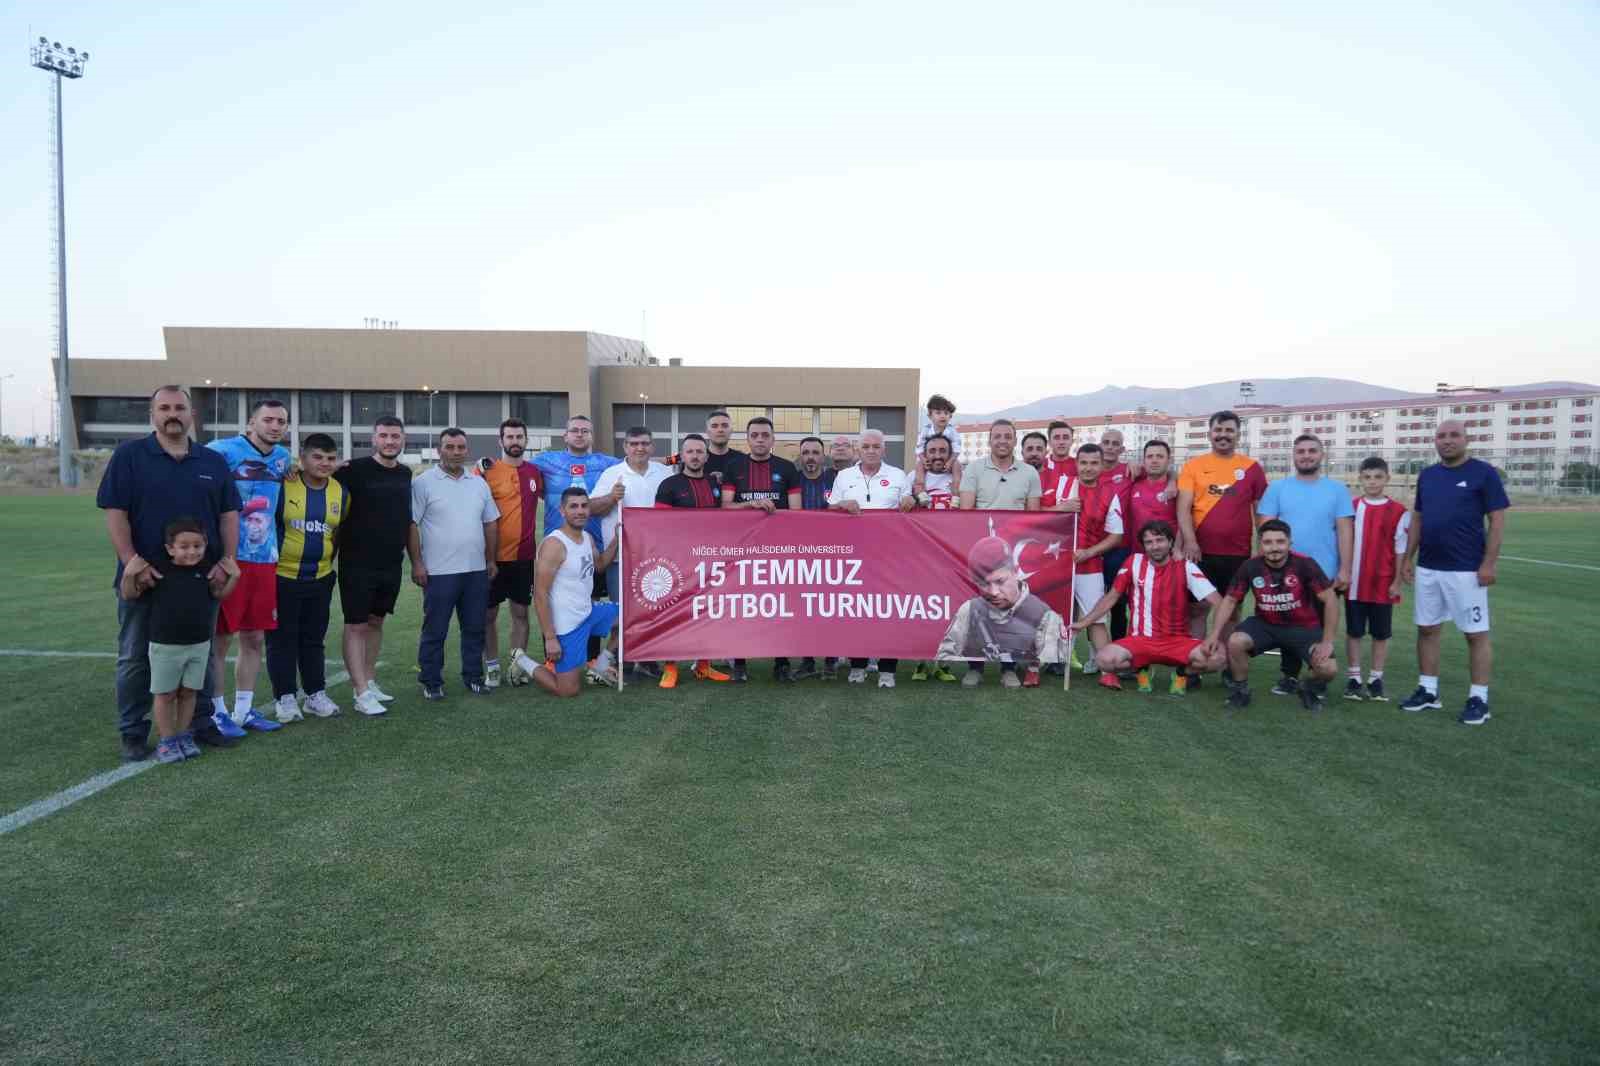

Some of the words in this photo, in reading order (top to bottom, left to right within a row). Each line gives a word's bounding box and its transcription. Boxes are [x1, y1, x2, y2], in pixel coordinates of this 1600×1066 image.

[719, 545, 744, 556] ÖMER
[746, 544, 797, 555] HALİSDEMİR
[798, 543, 854, 555] ÜNİVERSİTESİ
[694, 561, 726, 588] 15
[735, 559, 863, 586] TEMMUZ
[691, 593, 794, 620] FUTBOL
[801, 592, 950, 621] TURNUVASI
[1472, 606, 1482, 623] 3
